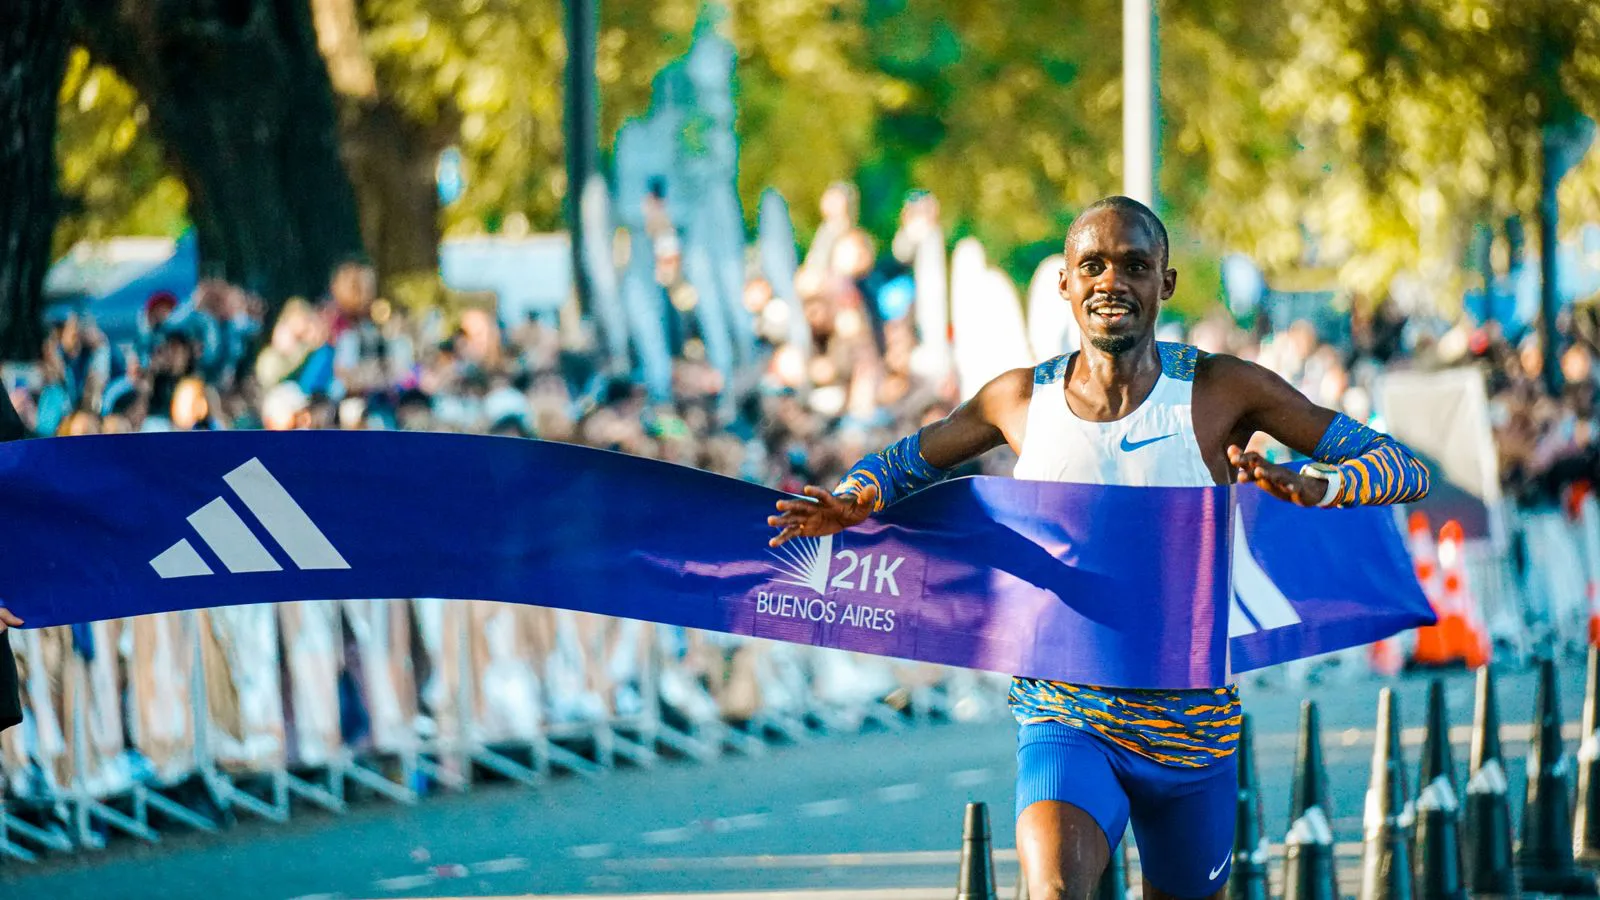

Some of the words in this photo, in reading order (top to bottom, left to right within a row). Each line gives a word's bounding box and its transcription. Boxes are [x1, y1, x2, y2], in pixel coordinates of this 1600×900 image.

[831, 550, 905, 596] 21K
[756, 592, 837, 623] BUENOS
[840, 604, 896, 632] AIRES
